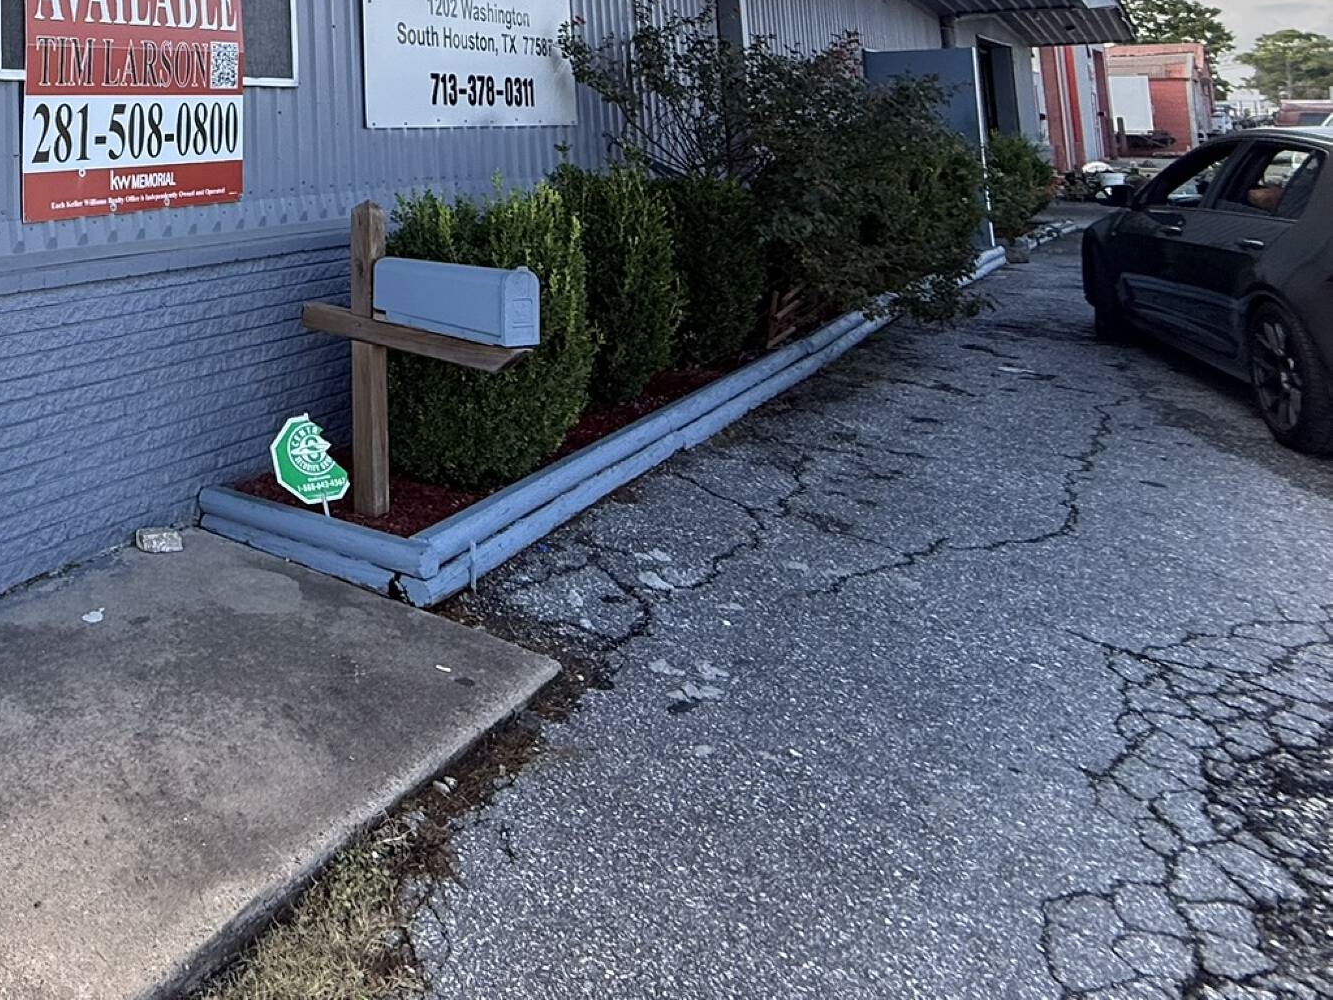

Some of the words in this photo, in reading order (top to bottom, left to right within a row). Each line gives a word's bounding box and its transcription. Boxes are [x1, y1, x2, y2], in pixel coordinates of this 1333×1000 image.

[460, 0, 531, 30] Washington
[397, 21, 440, 48] South
[443, 27, 499, 56] Houston,
[501, 33, 517, 55] TX
[36, 34, 97, 88] TIM
[101, 38, 210, 88] LARSON
[430, 72, 536, 108] 713-378-0311
[31, 101, 239, 165] 281-508-0800
